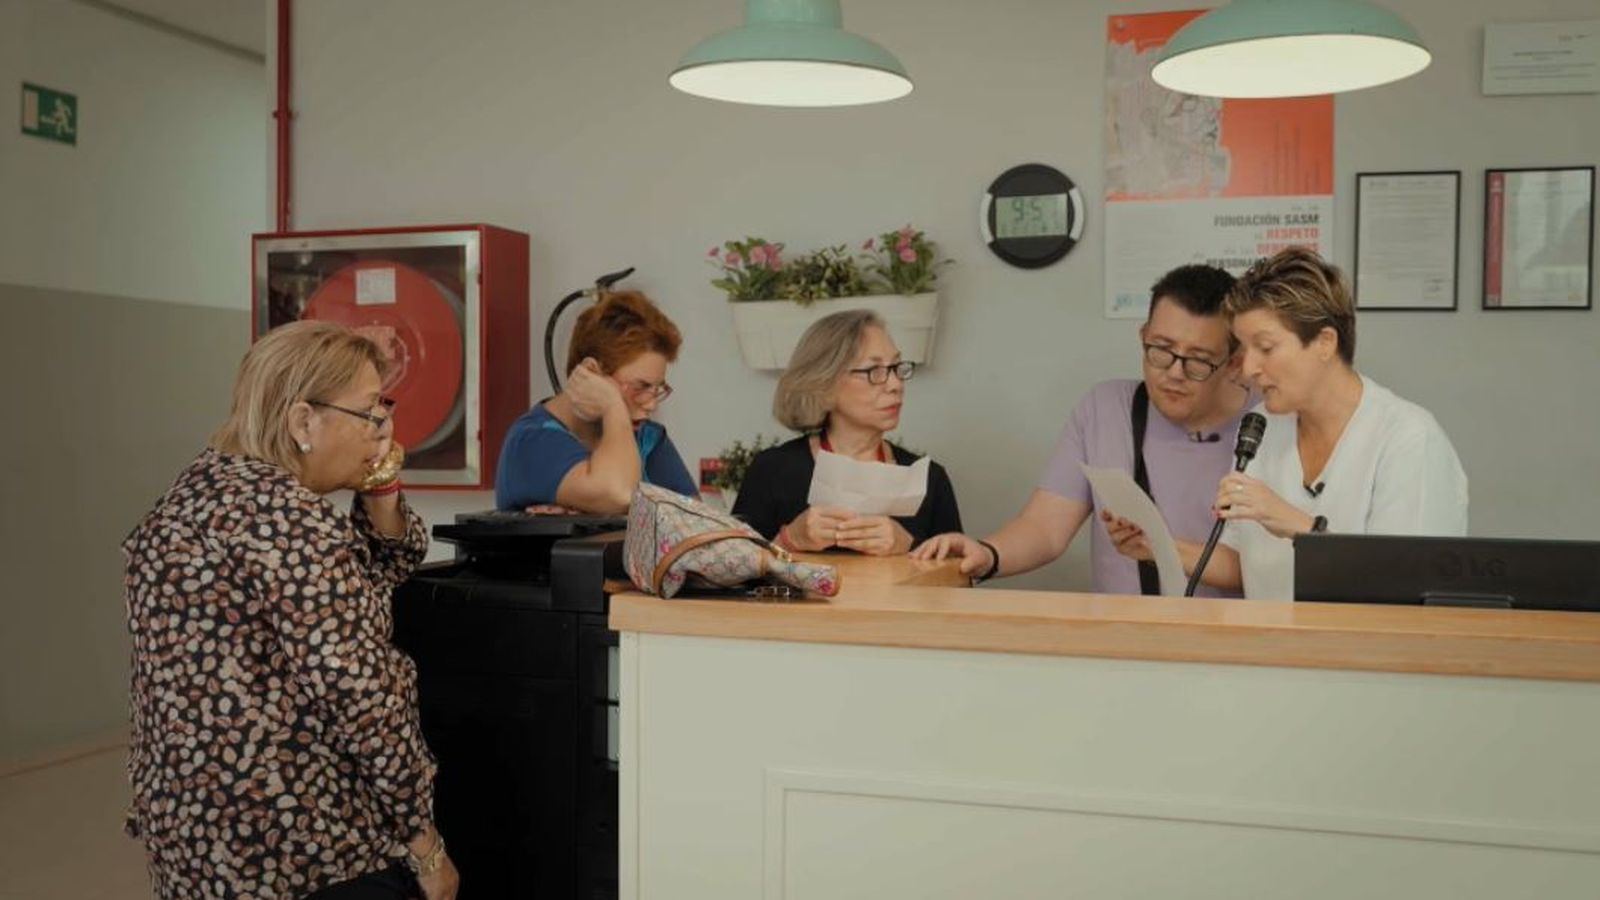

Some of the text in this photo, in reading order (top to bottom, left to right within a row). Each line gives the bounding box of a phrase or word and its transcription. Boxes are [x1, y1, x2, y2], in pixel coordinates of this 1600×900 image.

[1214, 212, 1320, 227] FUNDACIÓN SASM
[1266, 227, 1319, 239] RESPETO
